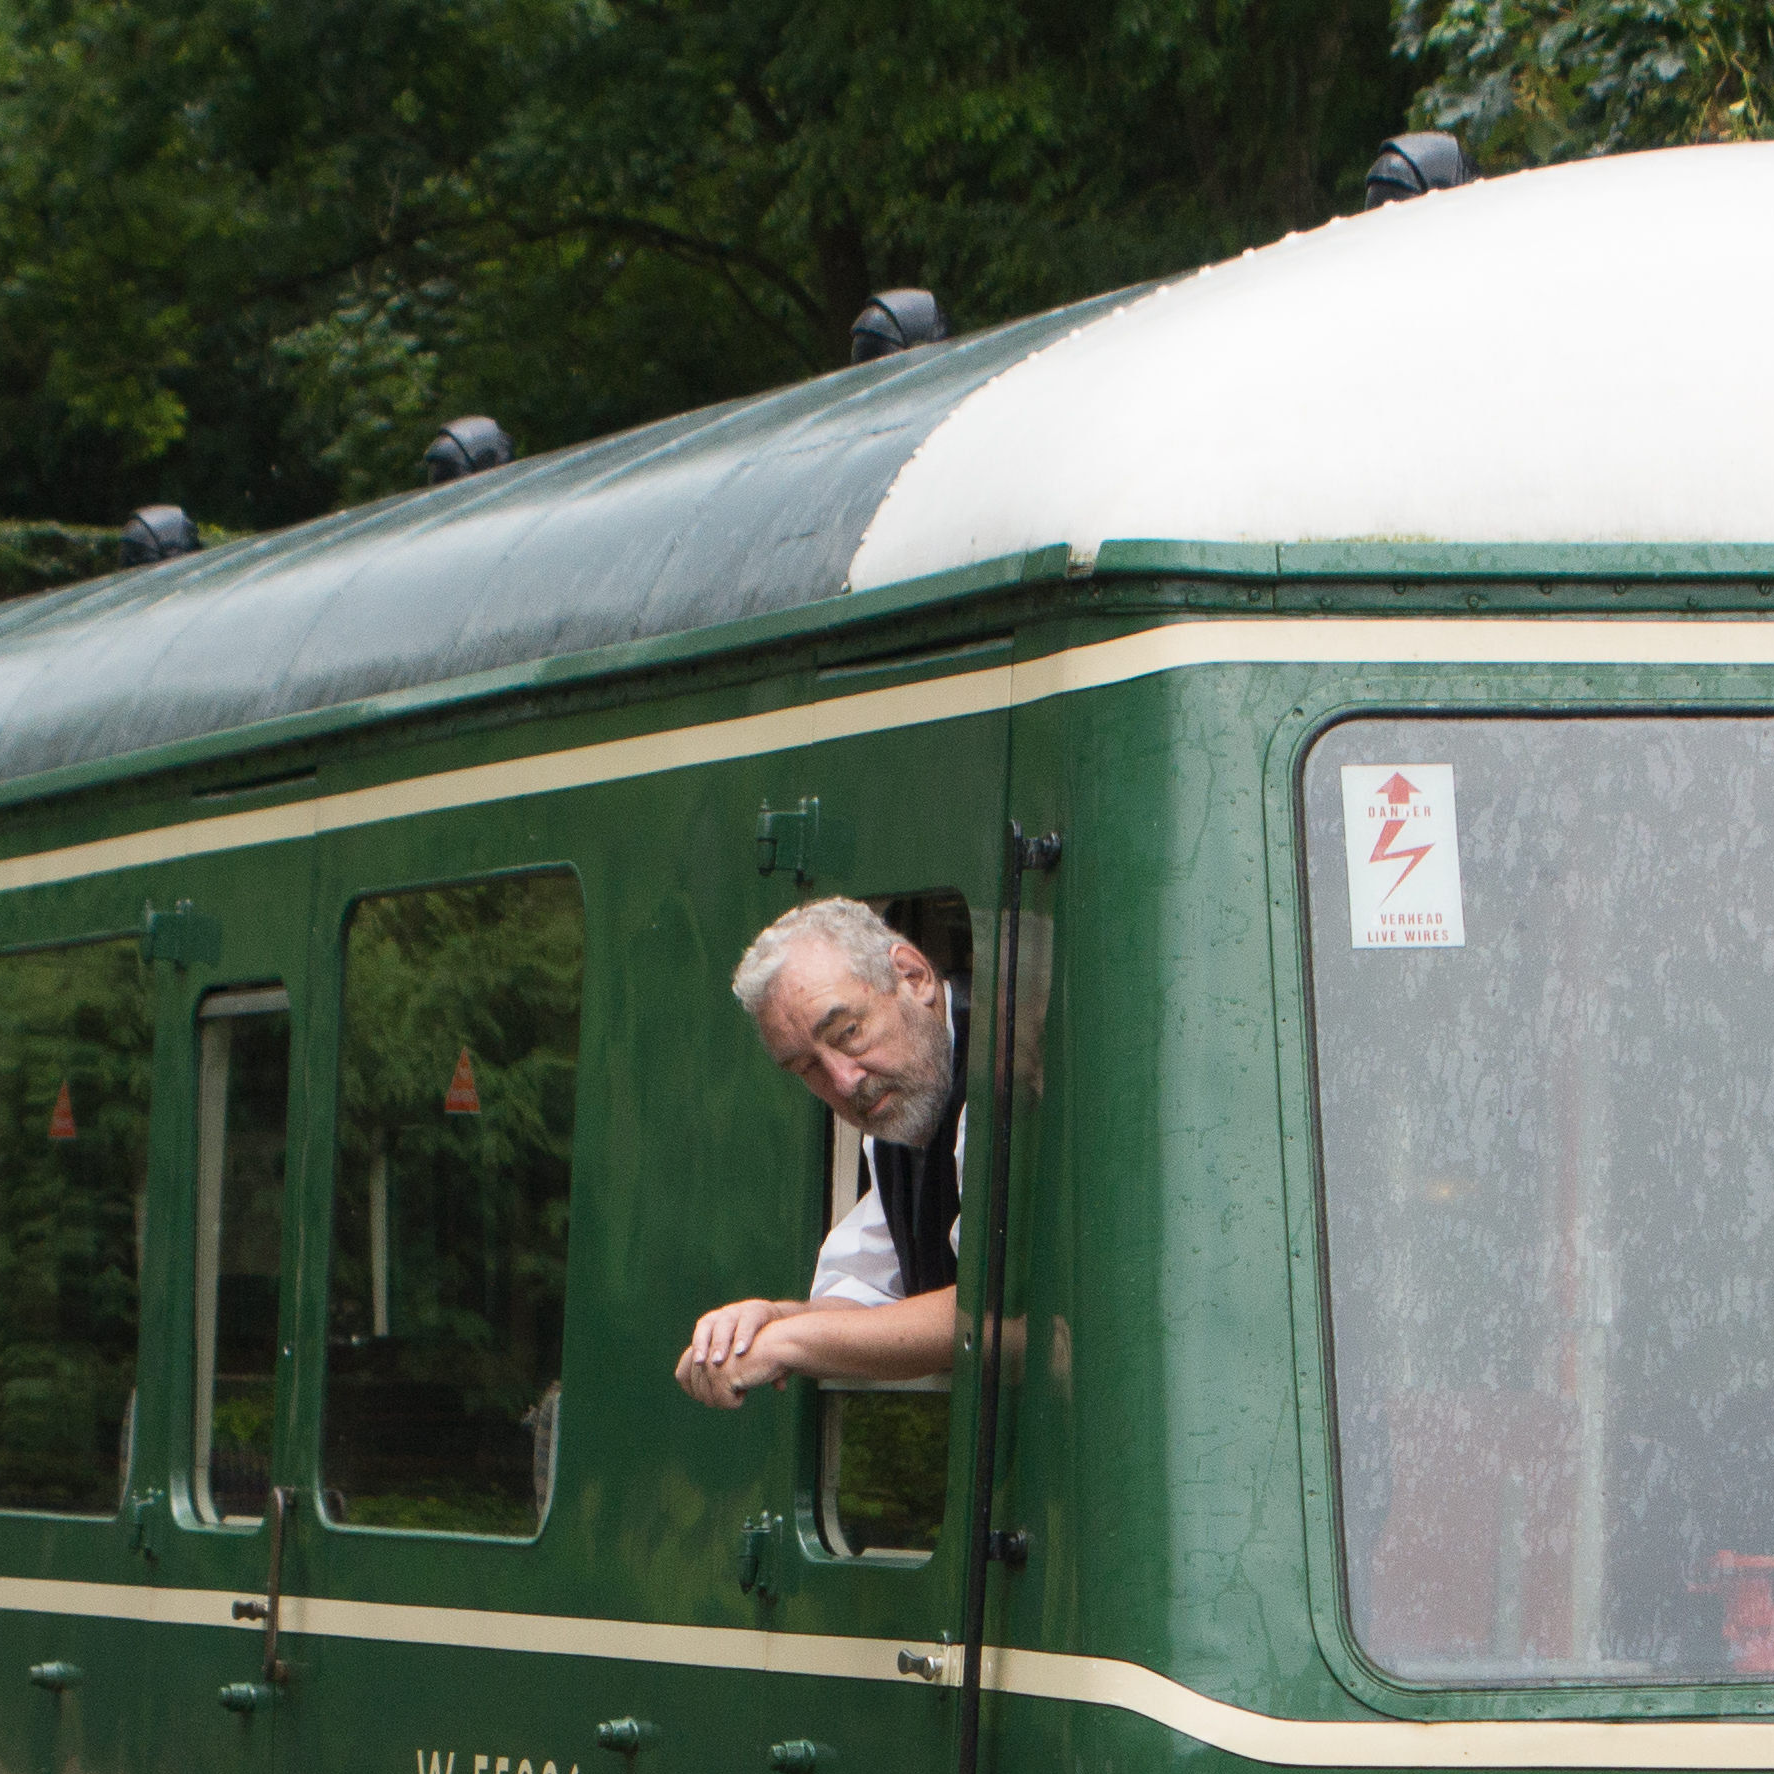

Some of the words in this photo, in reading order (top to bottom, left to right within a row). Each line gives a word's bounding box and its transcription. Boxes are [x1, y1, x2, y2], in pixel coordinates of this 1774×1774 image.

[1368, 806, 1431, 818] DANER
[1372, 912, 1443, 925] VERHEAD
[1367, 930, 1396, 943] LIVE
[1404, 930, 1449, 942] WIRES
